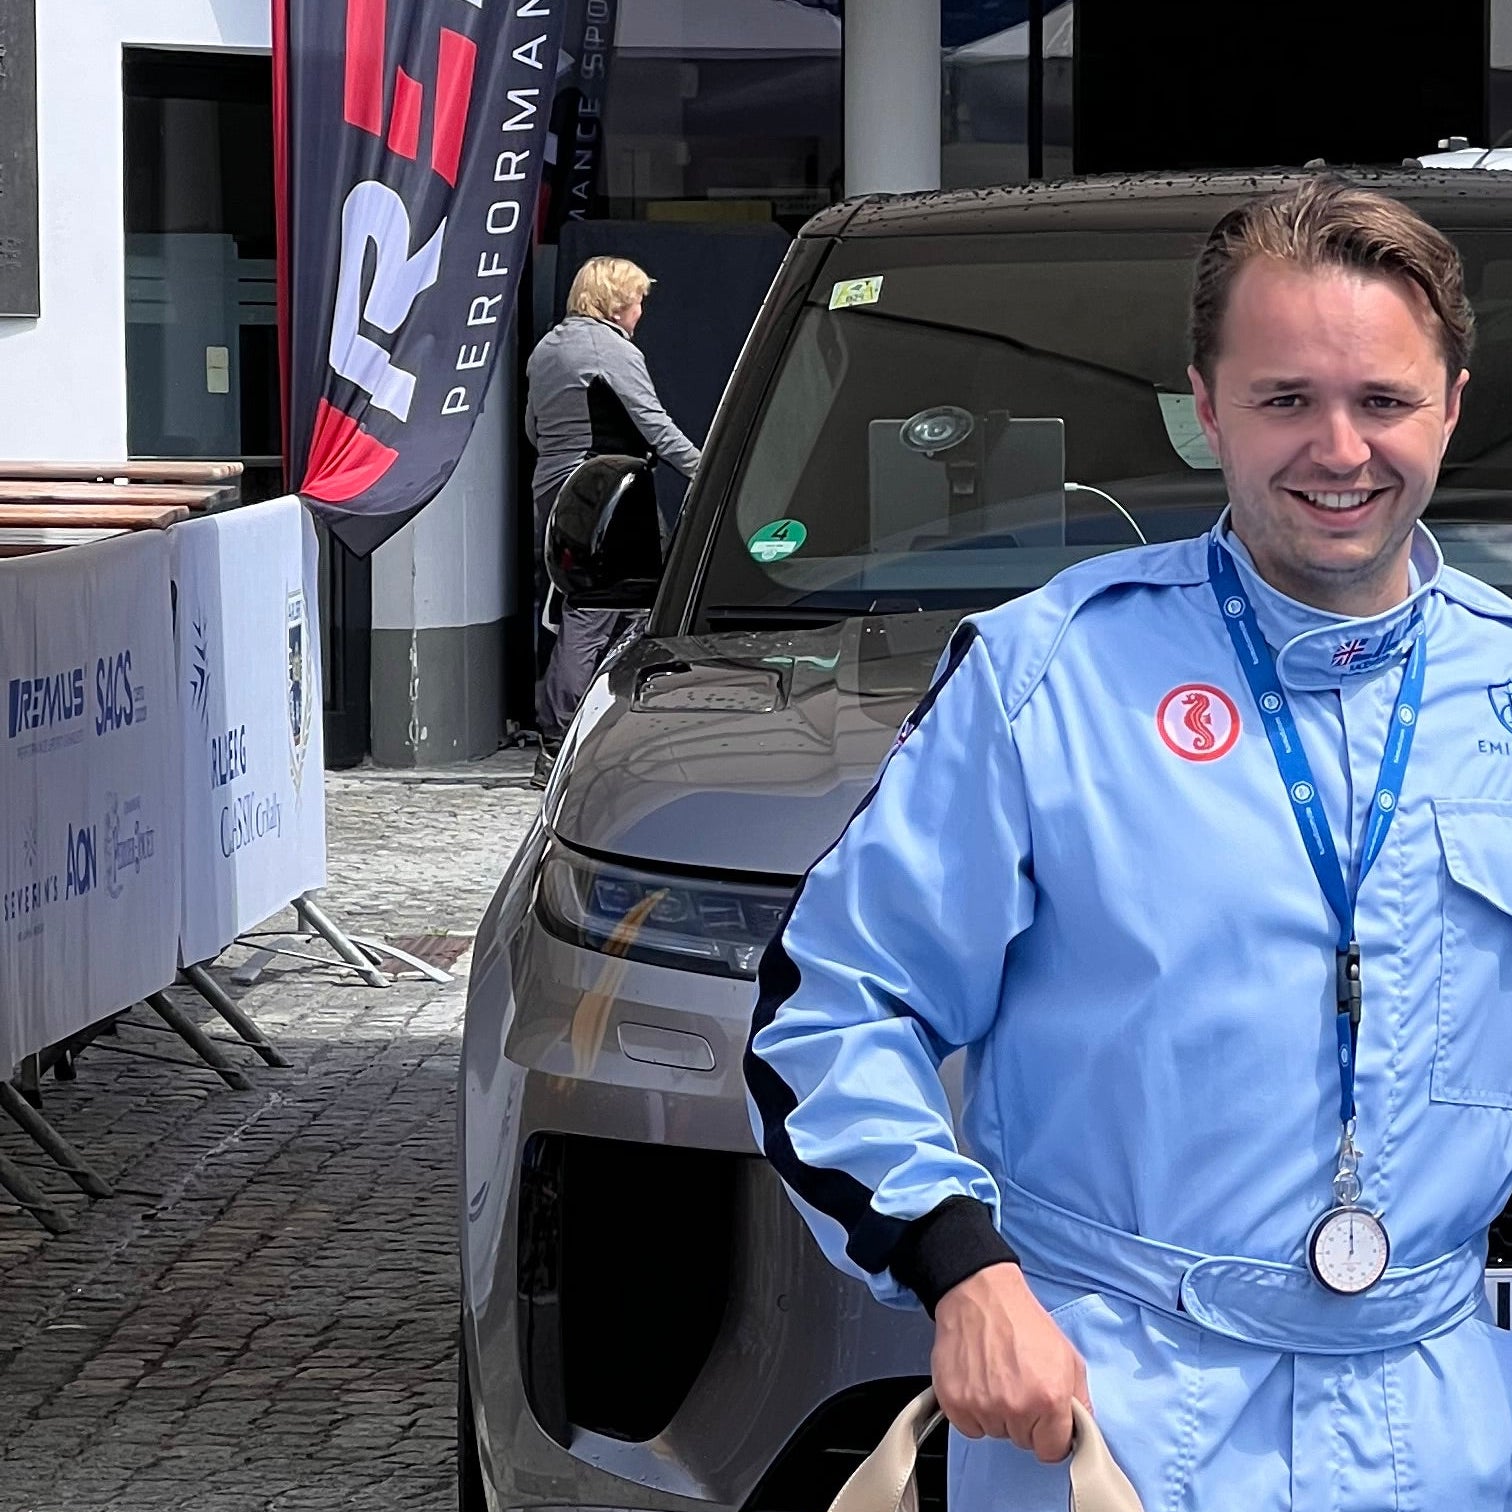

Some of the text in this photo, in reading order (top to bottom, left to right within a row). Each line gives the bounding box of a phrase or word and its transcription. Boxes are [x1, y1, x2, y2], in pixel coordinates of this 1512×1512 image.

[771, 521, 791, 541] 4
[12, 668, 84, 736] REMUS
[96, 649, 133, 736] SACS
[66, 822, 97, 901] AON
